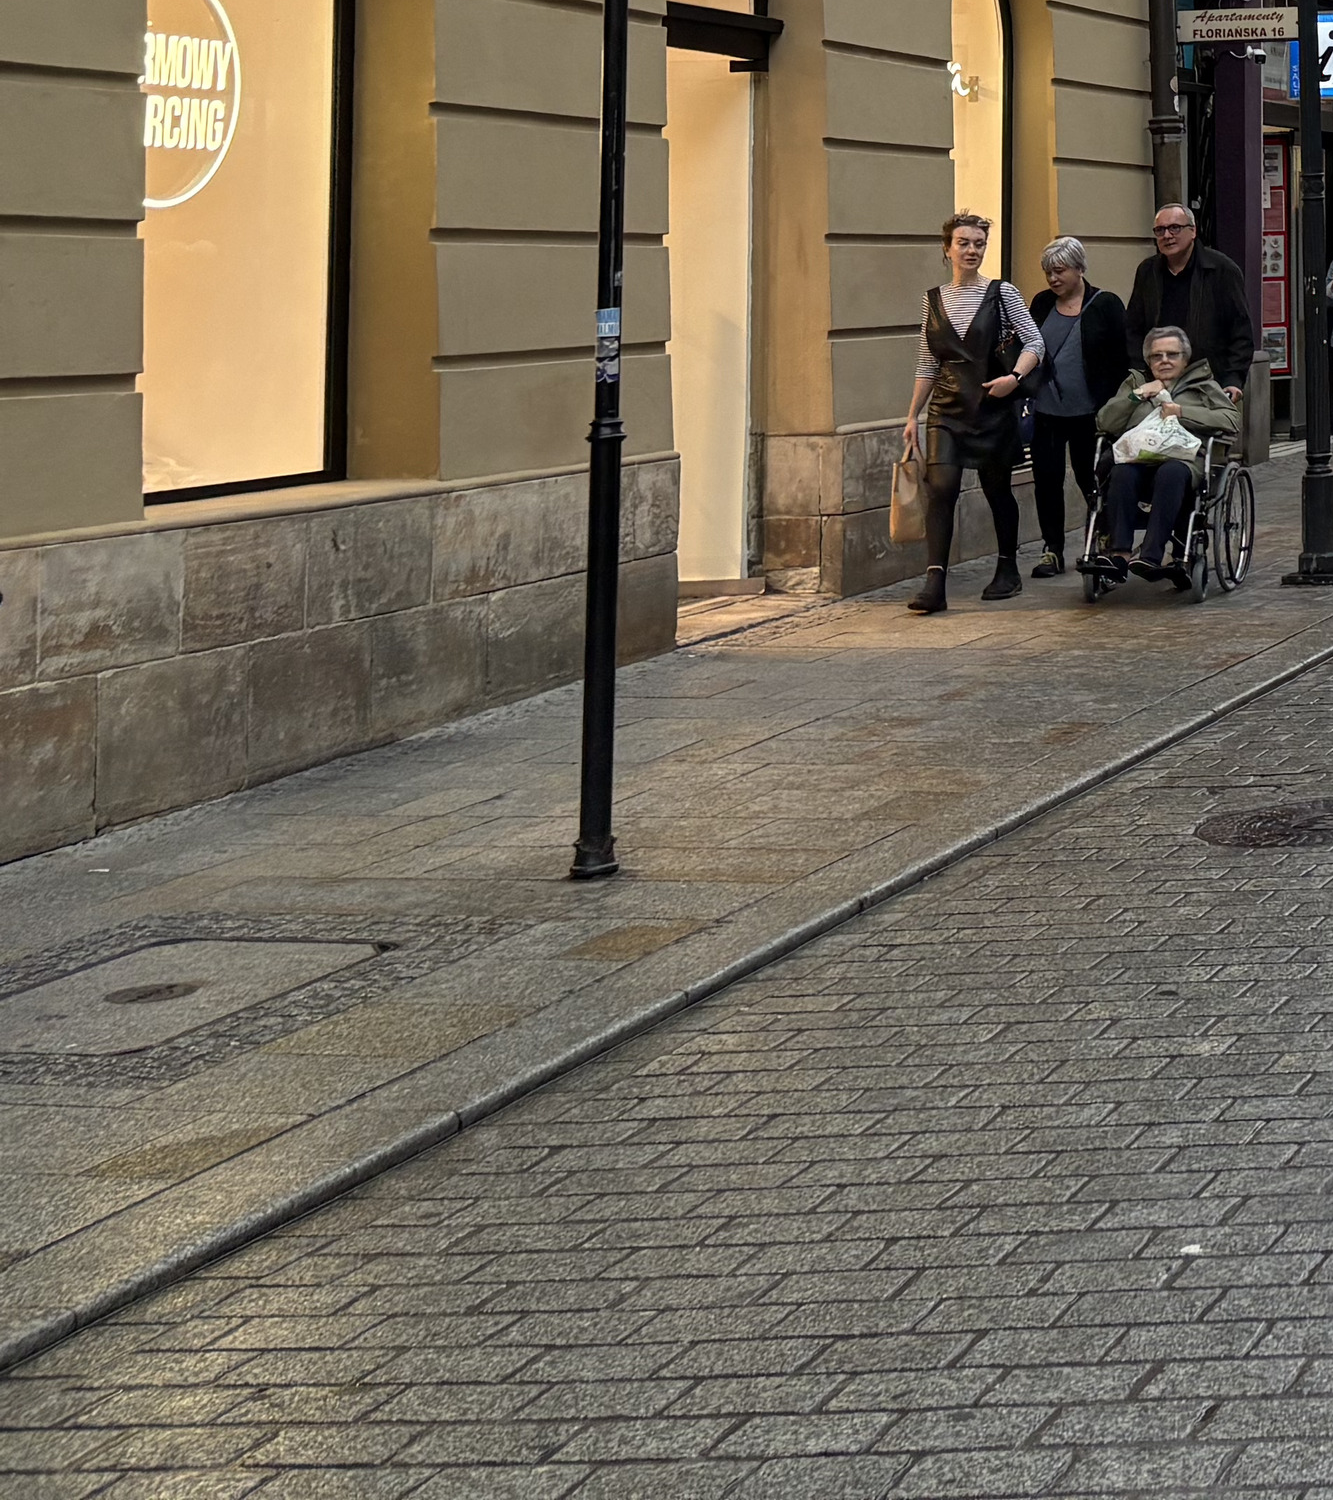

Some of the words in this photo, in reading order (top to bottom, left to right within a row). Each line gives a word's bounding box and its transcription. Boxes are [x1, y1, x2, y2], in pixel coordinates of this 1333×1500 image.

[1193, 10, 1285, 25] Apartamenty
[1193, 26, 1267, 39] FLORIAŃSKA
[1271, 27, 1285, 38] 16
